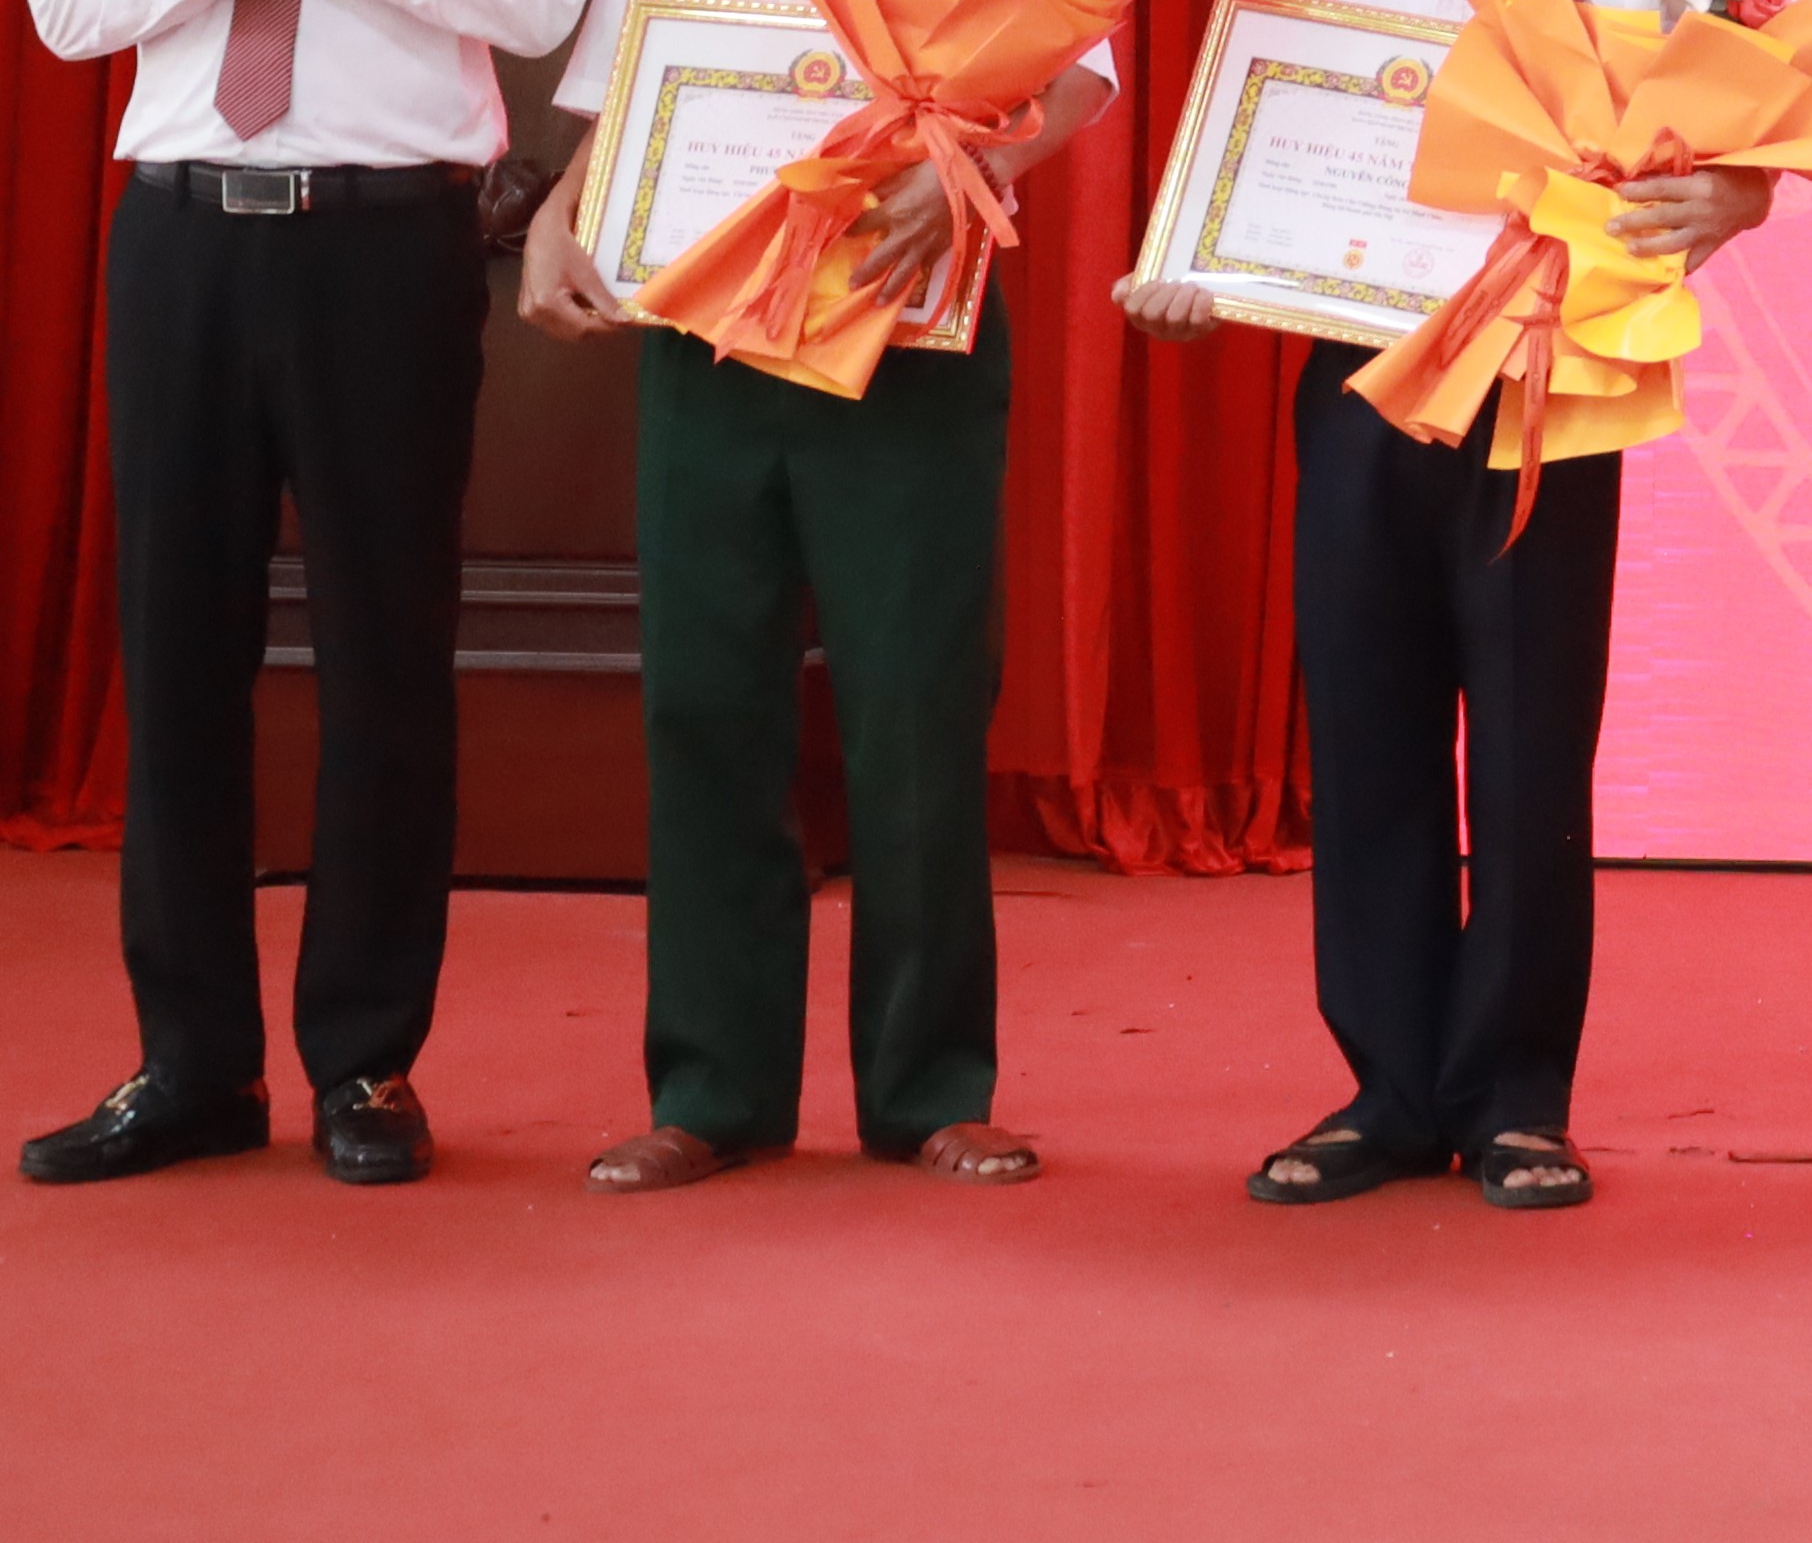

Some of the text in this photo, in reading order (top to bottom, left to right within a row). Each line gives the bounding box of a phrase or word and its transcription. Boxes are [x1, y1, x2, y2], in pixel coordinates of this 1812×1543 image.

[687, 141, 719, 154] HUY
[1268, 135, 1404, 171] HUY HIỆU 45 NĂM
